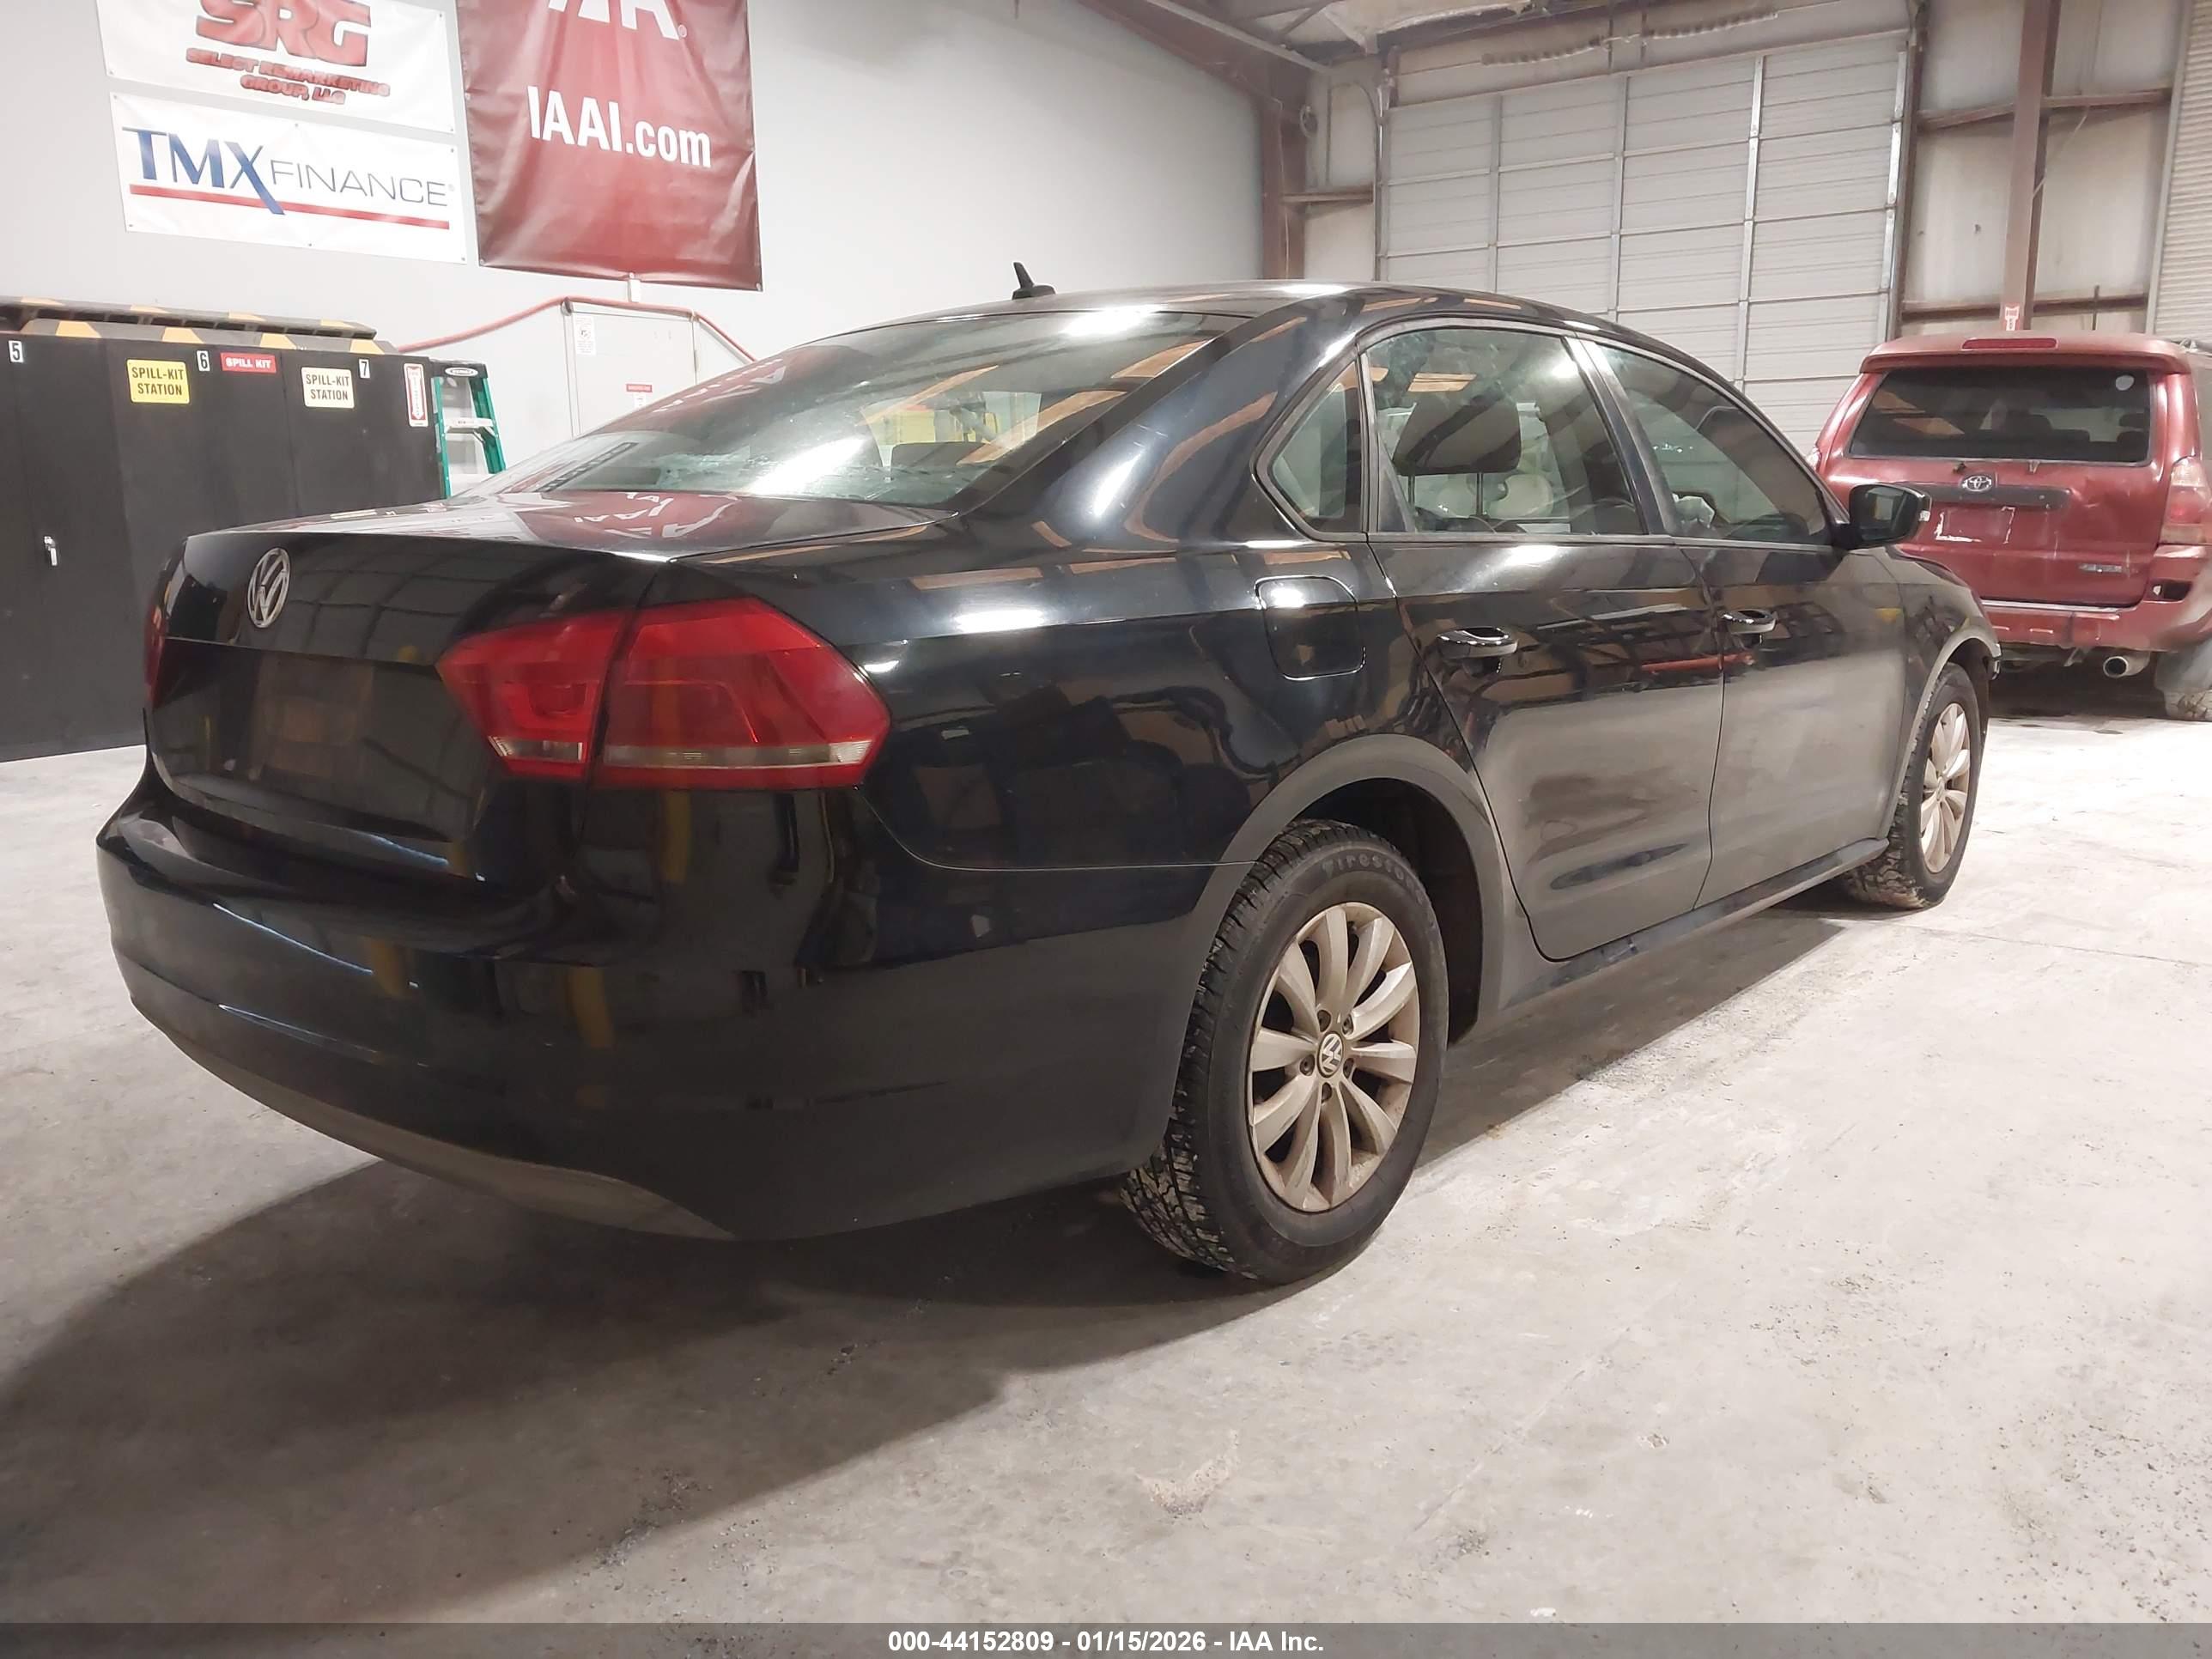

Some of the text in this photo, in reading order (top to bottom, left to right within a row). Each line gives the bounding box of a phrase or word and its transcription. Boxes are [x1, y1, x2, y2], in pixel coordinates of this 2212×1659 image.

[196, 0, 371, 66] SRG
[185, 48, 258, 73] SELECT
[527, 86, 711, 167] IAAI.com
[122, 126, 447, 216] TMX FINANCE
[12, 343, 21, 361] 5
[199, 351, 208, 369] 6
[225, 357, 272, 368] SPILL KIT
[361, 361, 368, 377] 7
[132, 367, 184, 380] SPILL-KIT
[306, 374, 350, 386] SPILL-KIT
[137, 383, 183, 396] STATION
[311, 389, 349, 401] STATION
